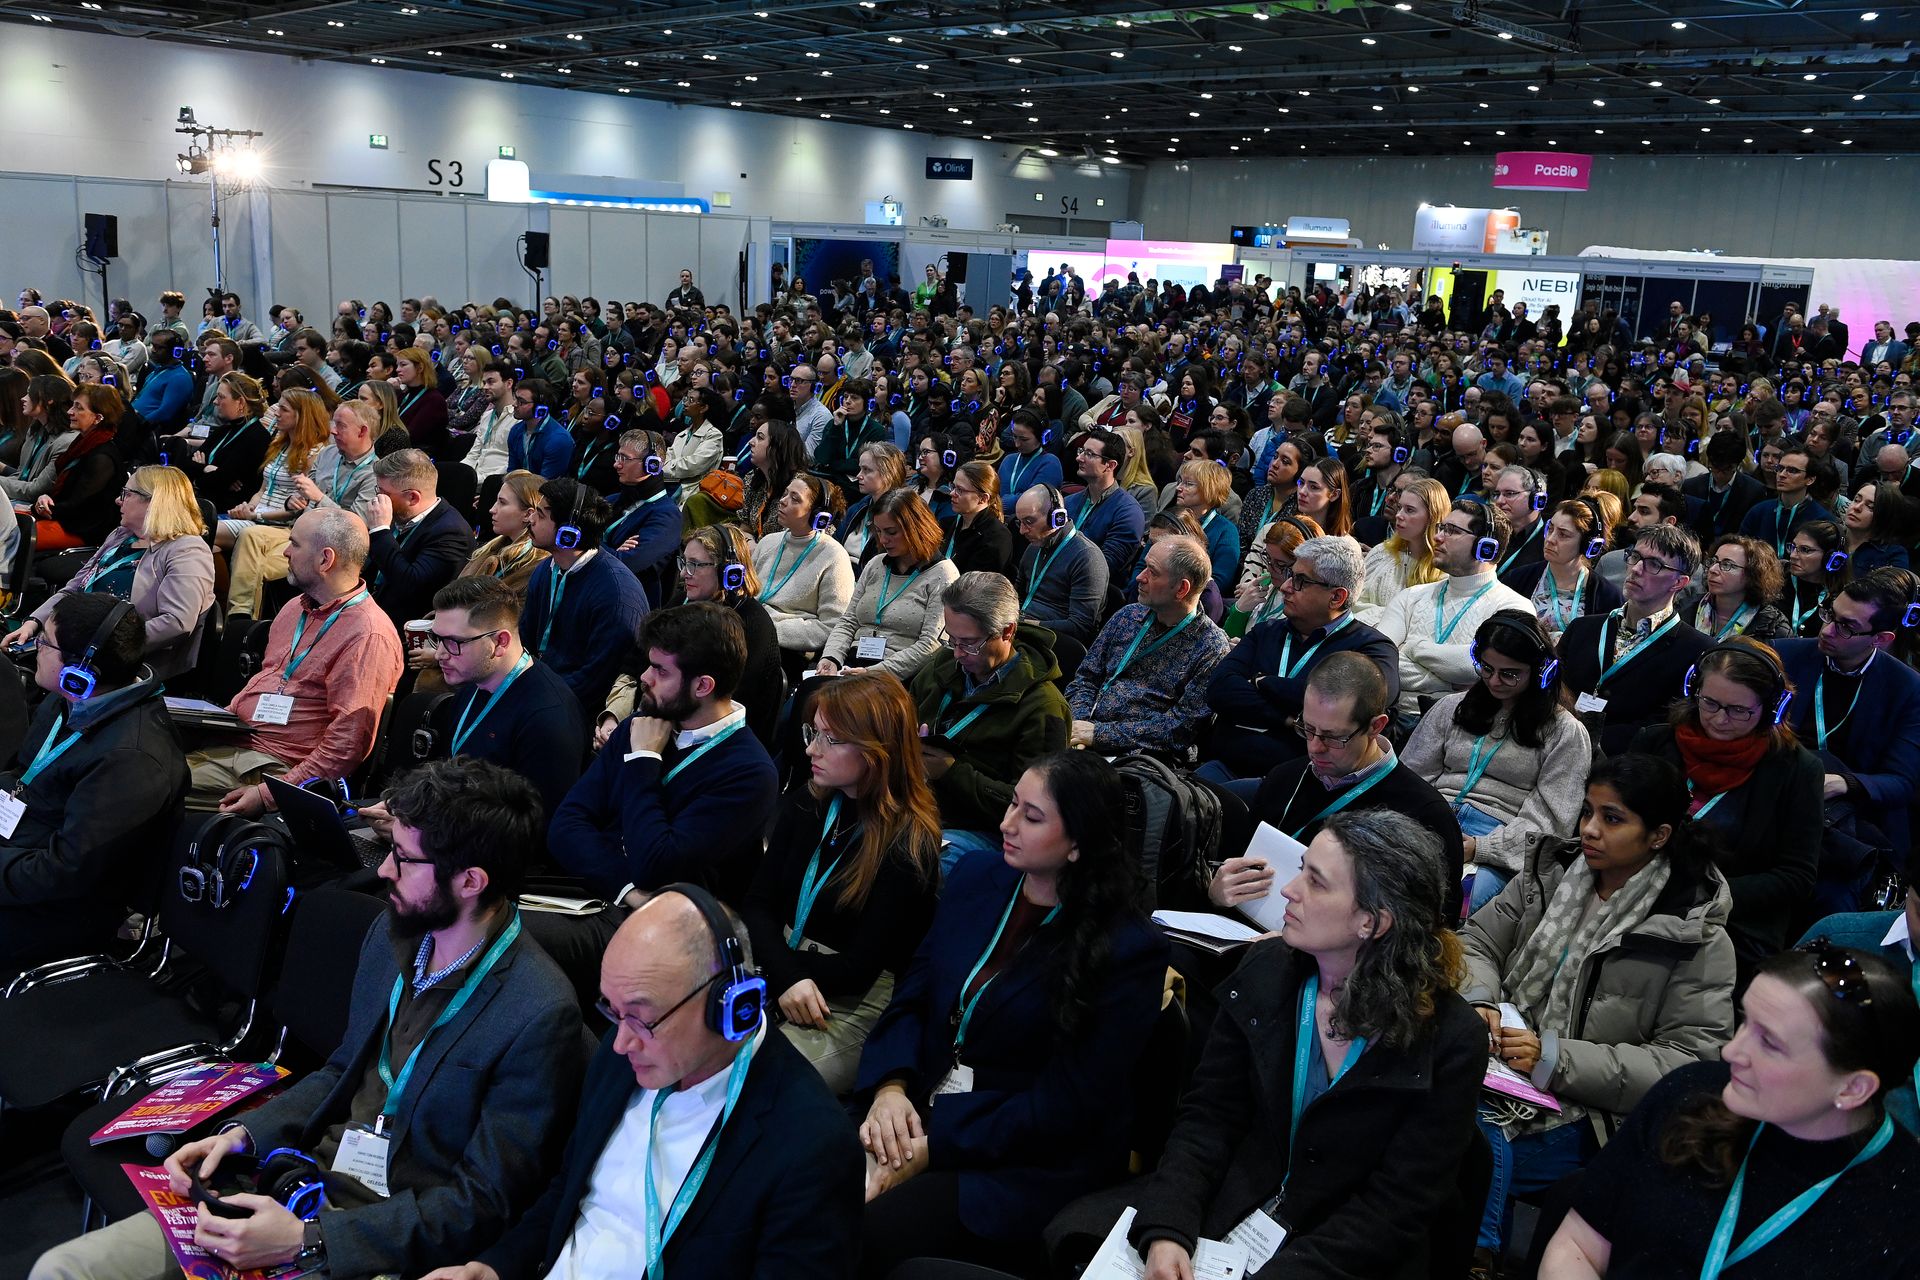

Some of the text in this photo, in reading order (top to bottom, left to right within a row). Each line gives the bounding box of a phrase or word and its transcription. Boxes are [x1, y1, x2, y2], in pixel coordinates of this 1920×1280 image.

[944, 164, 966, 173] Olink
[1534, 164, 1578, 177] PacBio
[1060, 196, 1079, 215] S4
[1303, 223, 1333, 232] illumina
[1431, 220, 1468, 231] illumina
[1523, 279, 1579, 293] NEBI
[130, 1102, 221, 1117] EVENT GUIDE
[139, 1171, 171, 1180] Festiv
[367, 1179, 387, 1188] DELEGAT
[649, 1222, 661, 1269] Novogene
